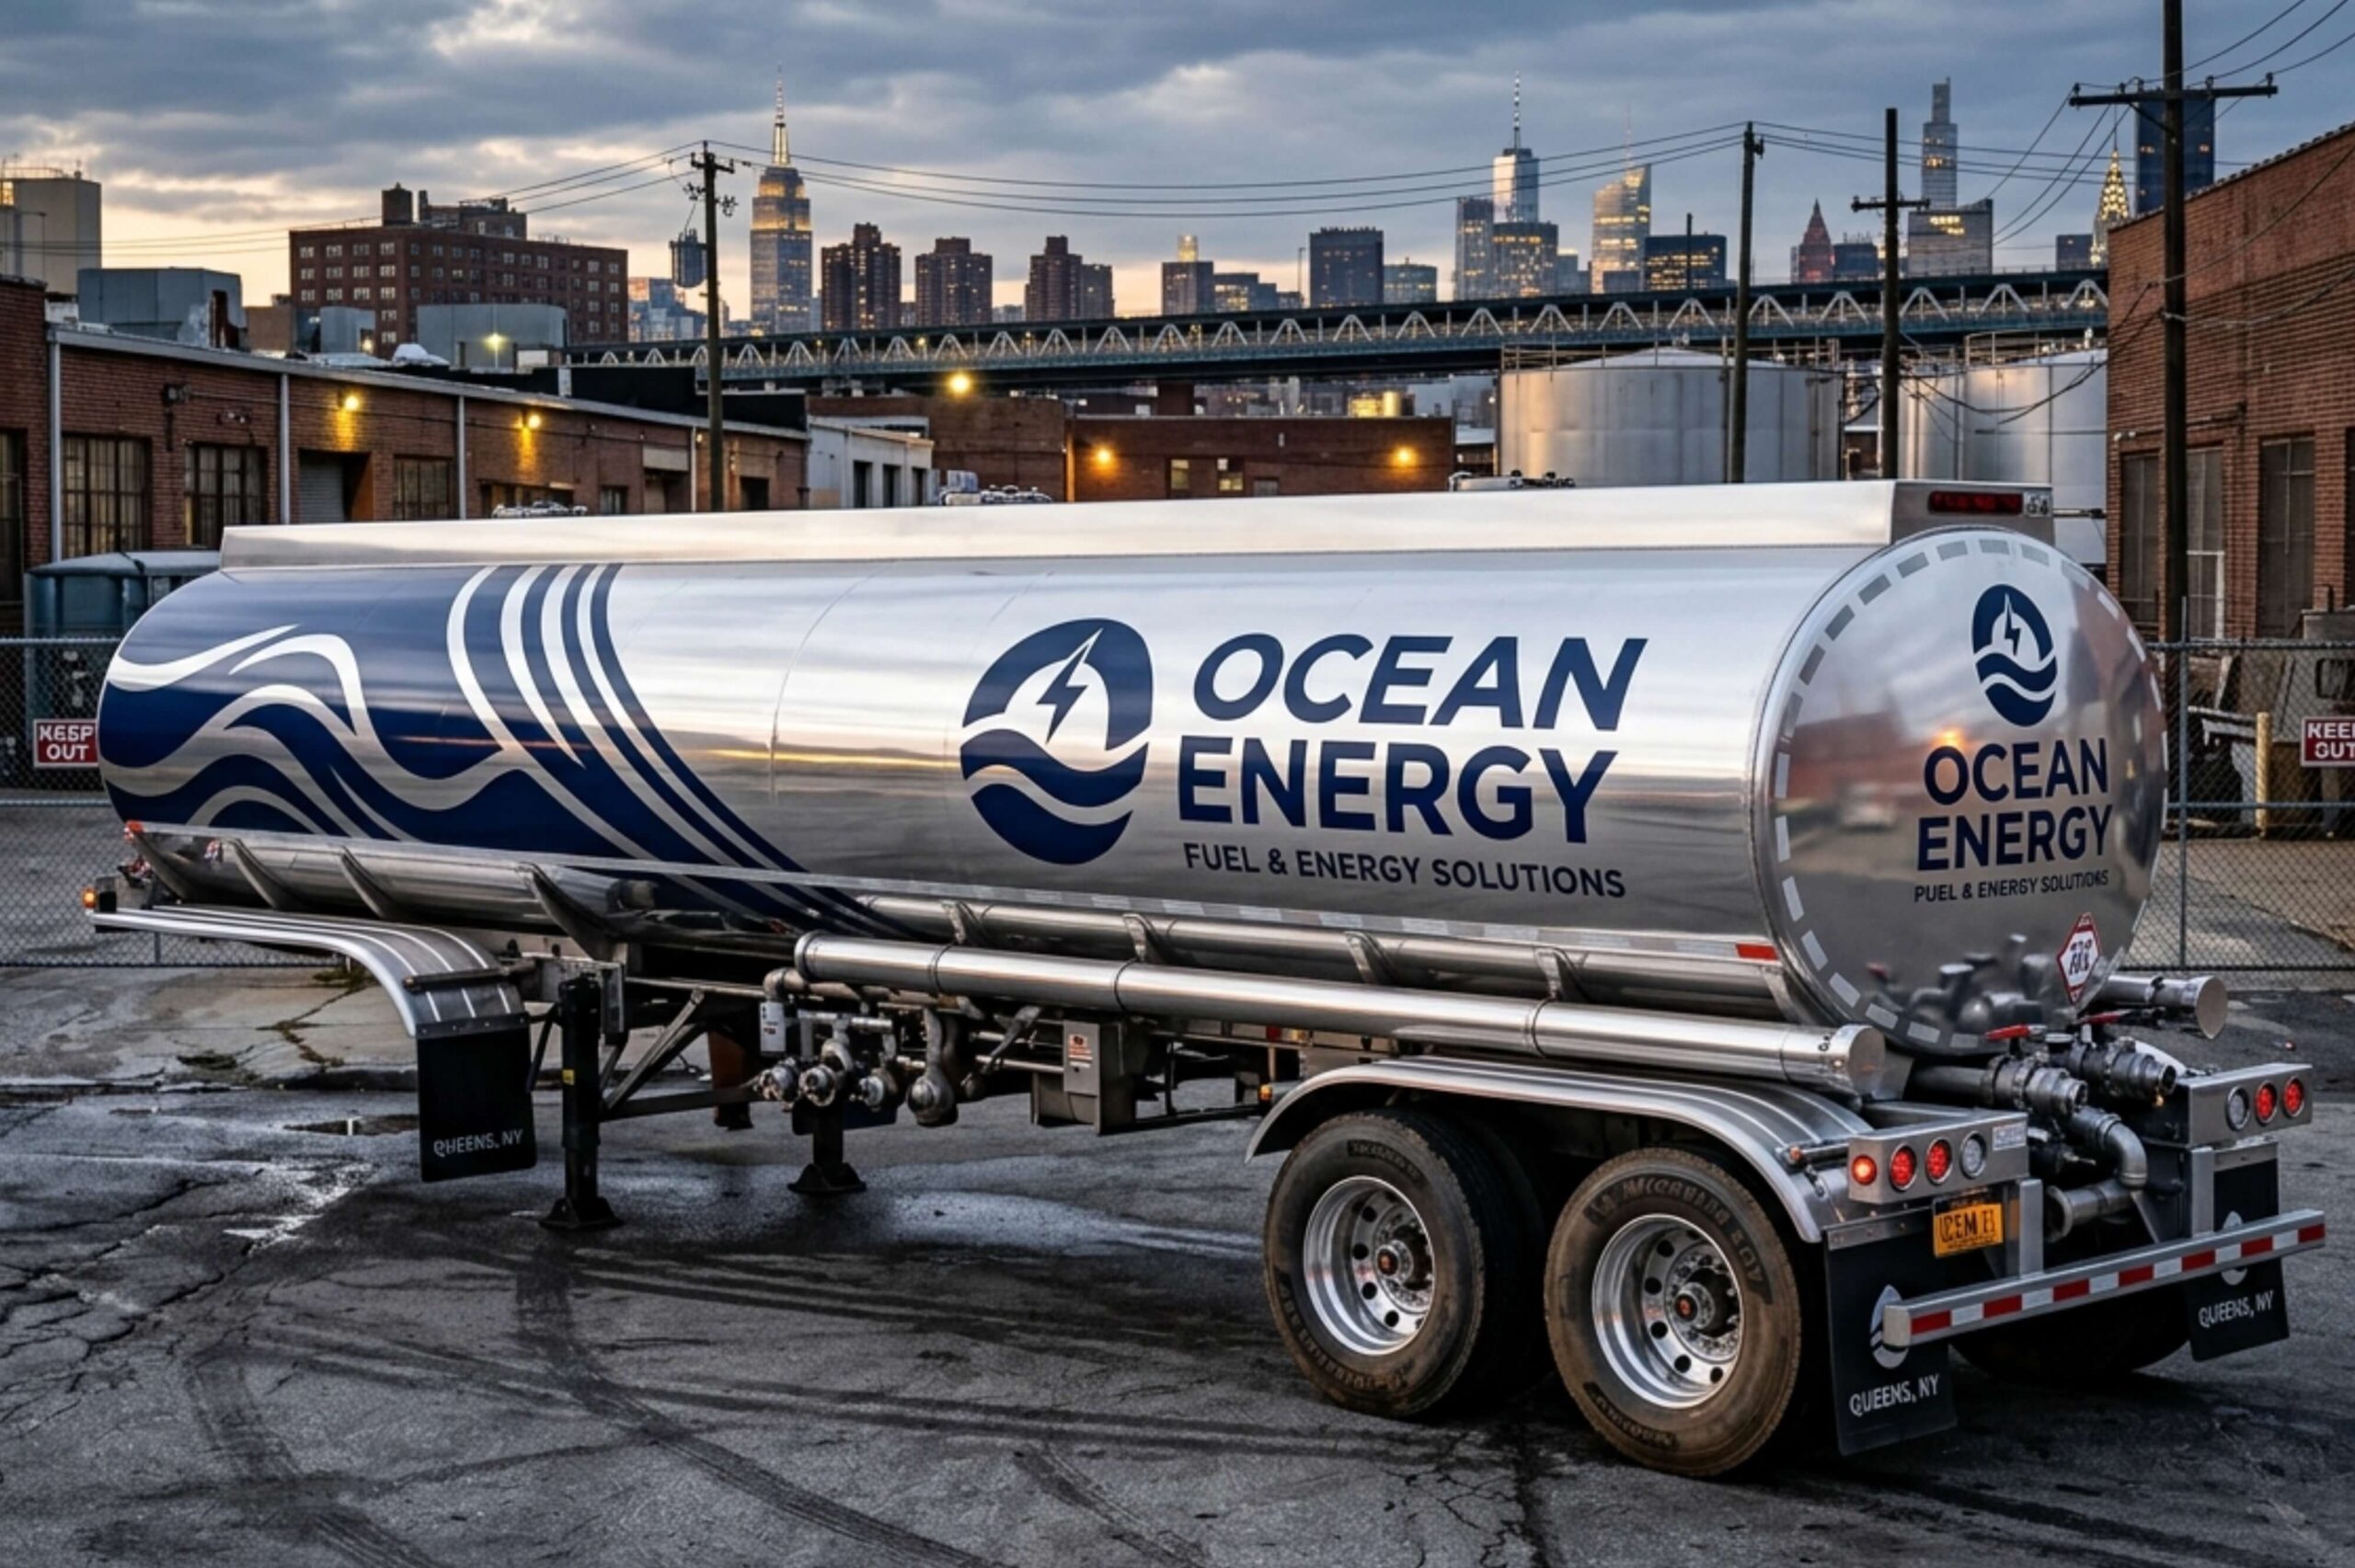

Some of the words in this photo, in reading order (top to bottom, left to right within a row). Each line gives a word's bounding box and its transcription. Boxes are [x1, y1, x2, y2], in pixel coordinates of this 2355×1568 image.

[1193, 633, 1648, 730] OCEAN
[46, 743, 89, 761] OUT
[1924, 737, 2108, 806] OCEAN
[1178, 736, 1618, 843] ENERGY
[1917, 805, 2113, 871] ENERGY
[1184, 842, 1260, 874] FUEL
[1269, 848, 1288, 875] &
[1296, 850, 1420, 885] ENERGY
[1431, 858, 1626, 898] SOLUTIONS
[1962, 882, 1972, 899] &
[501, 1128, 523, 1146] NY
[2256, 1289, 2274, 1312] NY
[1849, 1380, 1917, 1417] QUEENS,
[1918, 1373, 1939, 1398] NY
